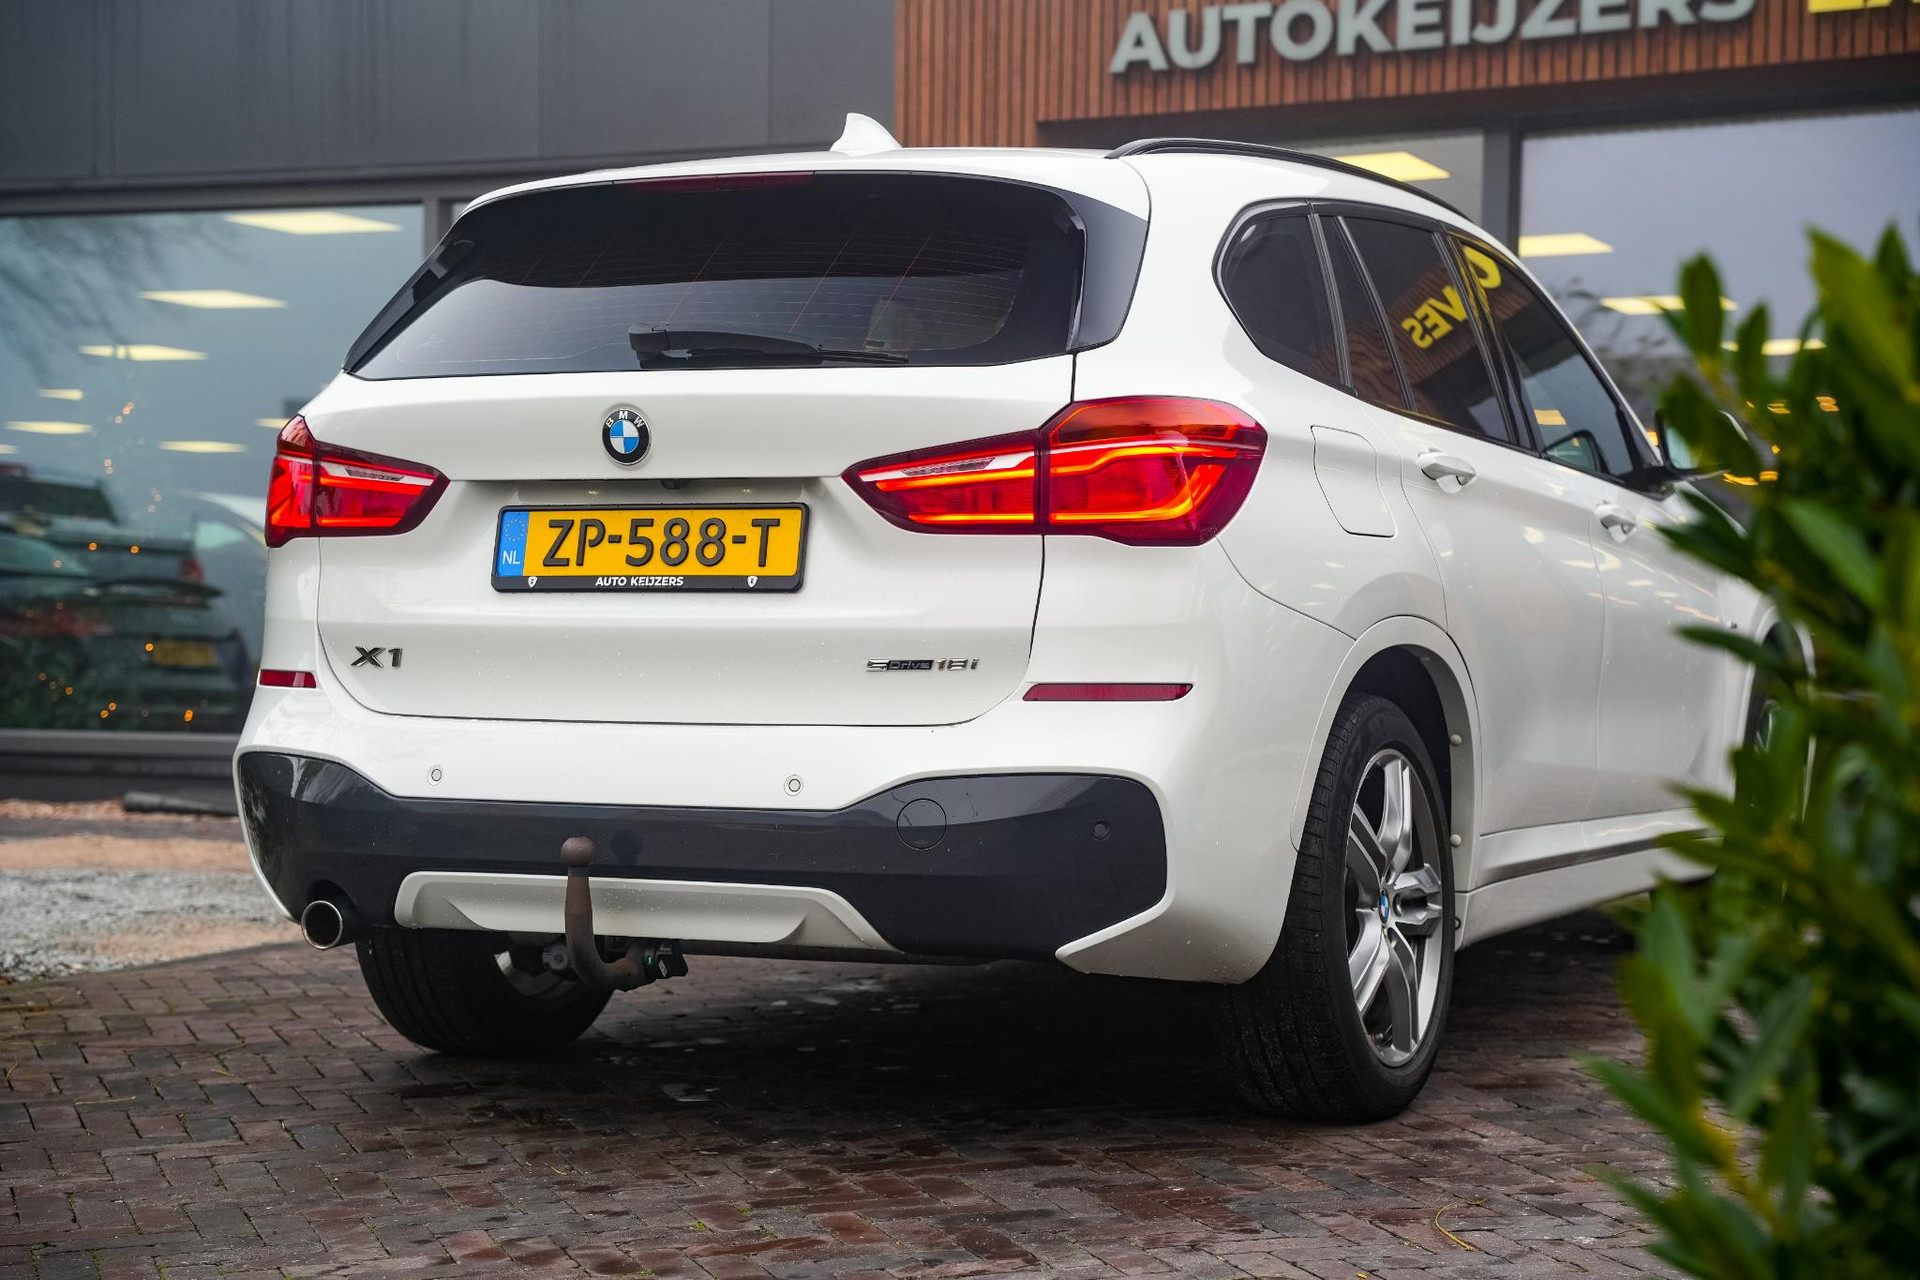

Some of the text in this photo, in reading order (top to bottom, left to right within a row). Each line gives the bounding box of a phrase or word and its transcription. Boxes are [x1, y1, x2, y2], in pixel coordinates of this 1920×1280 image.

[542, 517, 781, 568] ZP-588-T
[502, 549, 520, 565] NL
[595, 576, 684, 587] AUTO KEIJZERS
[350, 646, 403, 668] X1
